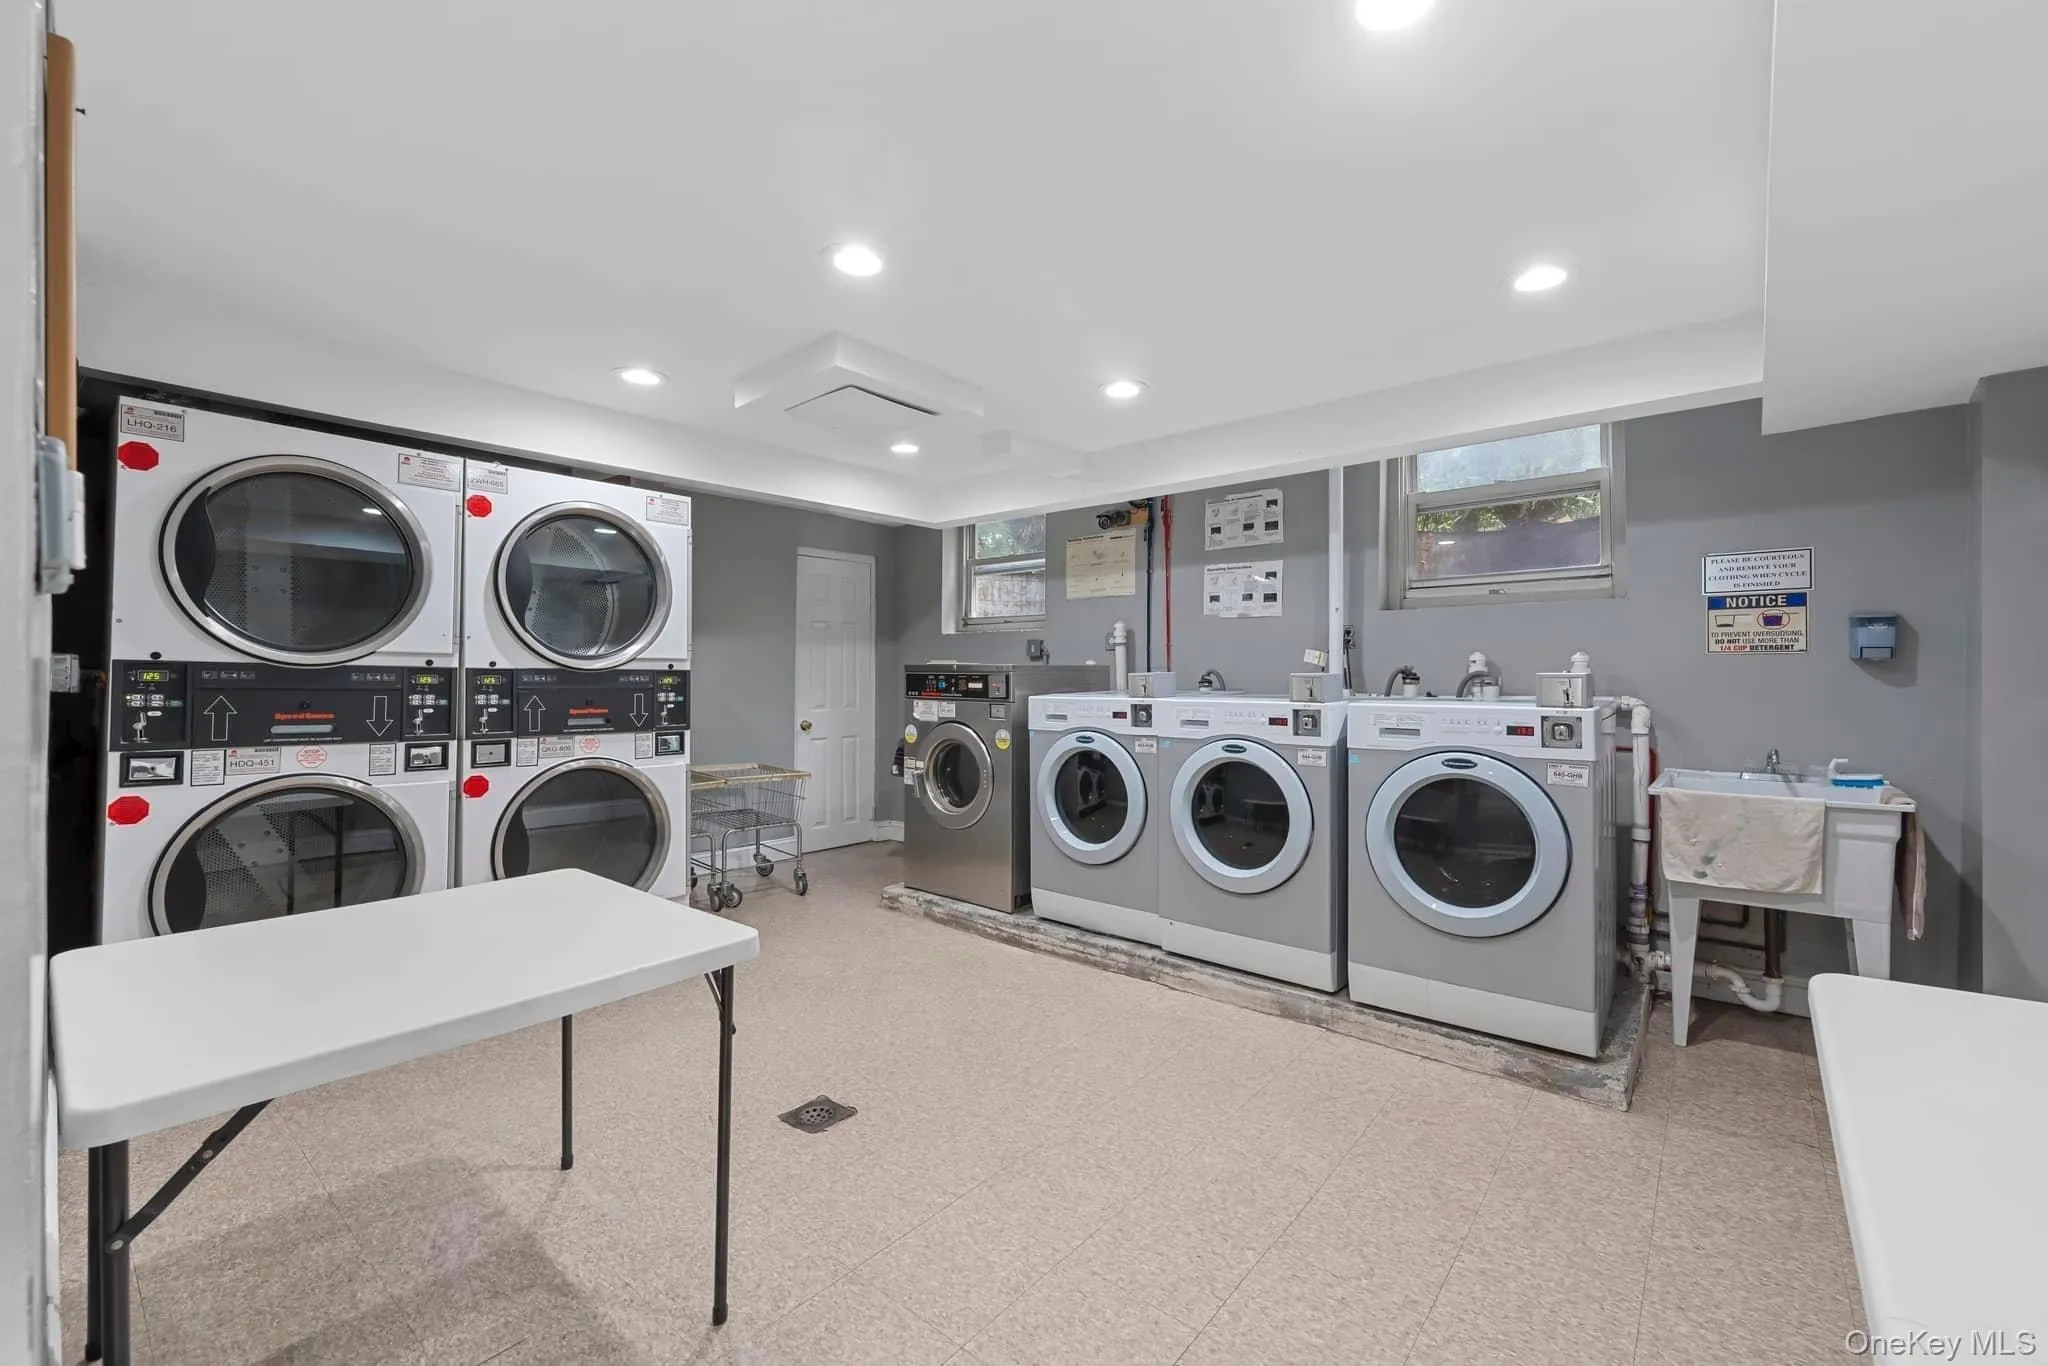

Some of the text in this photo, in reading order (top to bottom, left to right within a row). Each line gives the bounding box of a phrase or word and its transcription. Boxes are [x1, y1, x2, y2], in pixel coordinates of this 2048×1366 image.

[127, 418, 177, 433] LHQ-216
[1754, 553, 1805, 562] COURTEOUS
[1736, 563, 1771, 571] REMOVE
[1708, 573, 1750, 581] CLOTHING
[1779, 570, 1807, 578] CYCLE
[1742, 580, 1781, 588] FINISHED
[1726, 594, 1788, 608] NOTICE
[229, 759, 275, 768] HDQ-451
